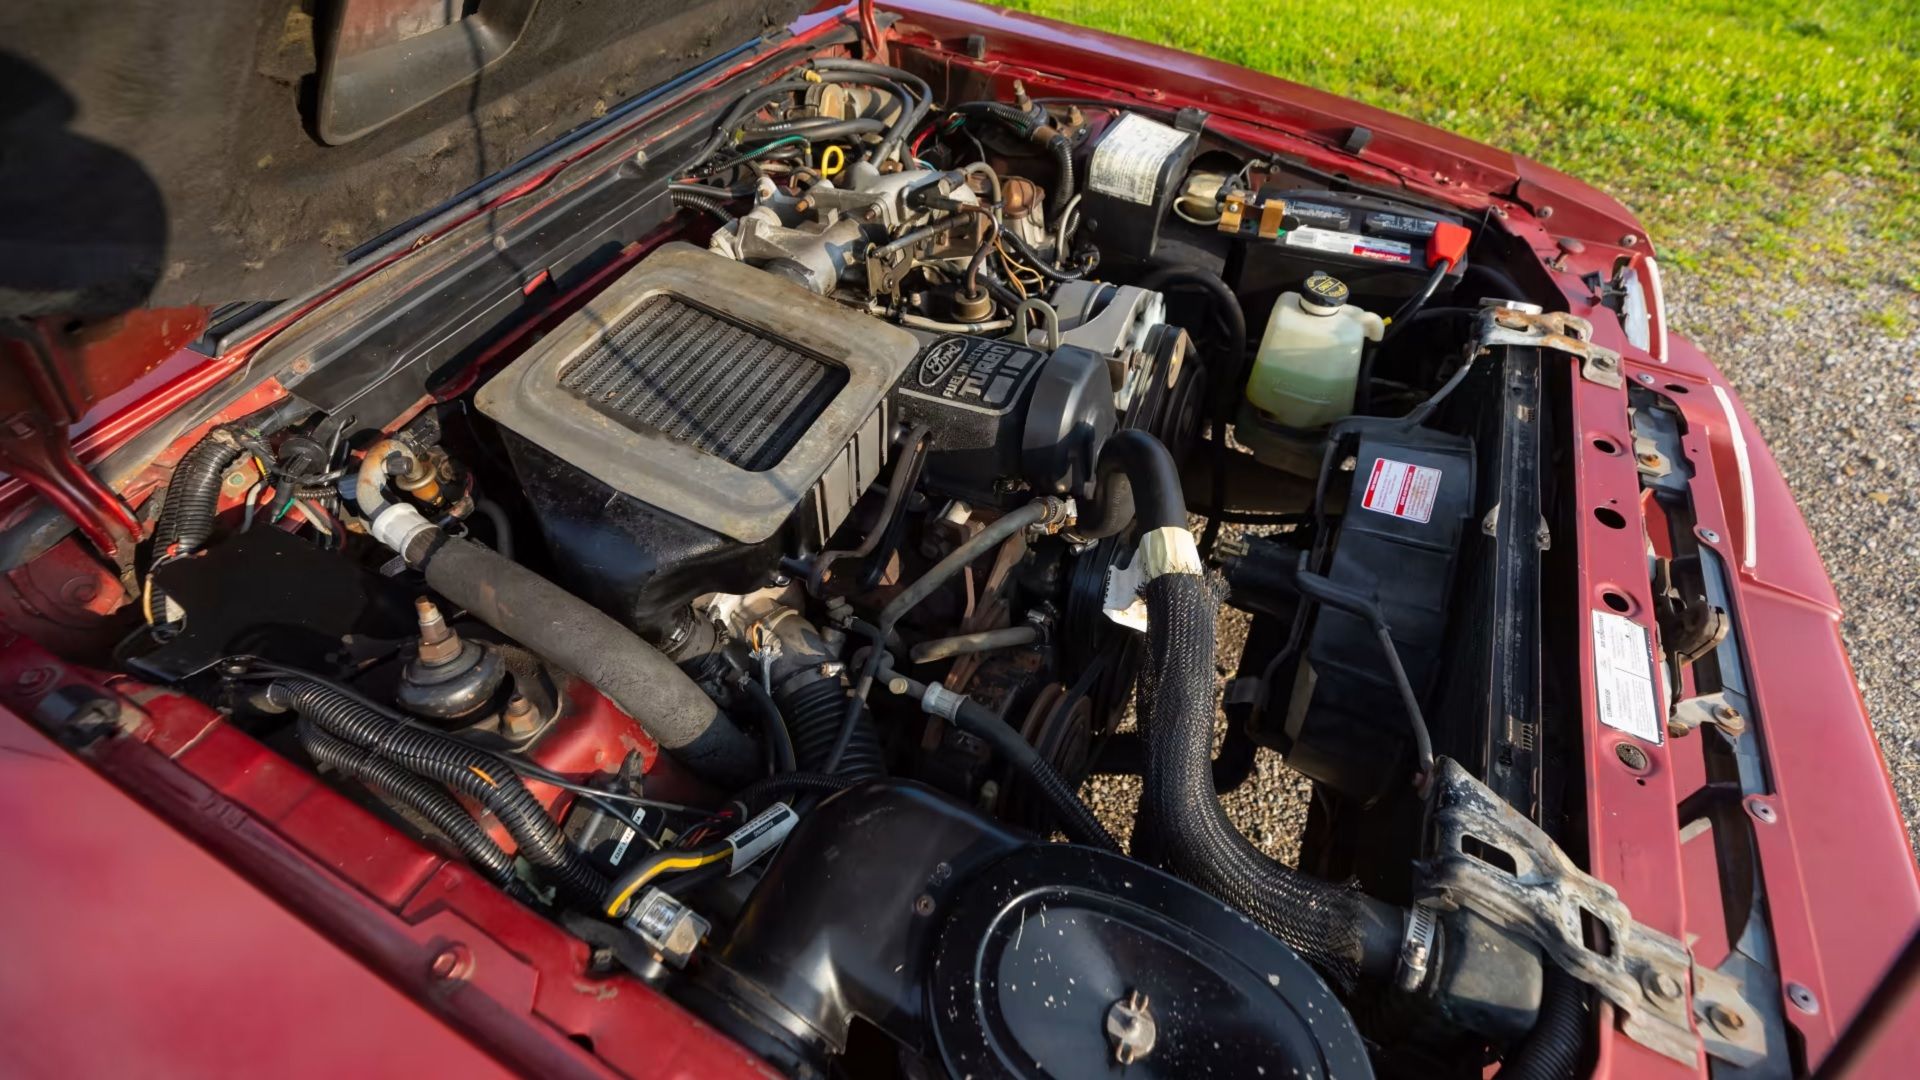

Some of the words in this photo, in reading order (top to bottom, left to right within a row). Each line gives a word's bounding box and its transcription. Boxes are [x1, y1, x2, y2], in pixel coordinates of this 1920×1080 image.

[926, 343, 961, 375] Ford
[942, 374, 967, 398] FUEL
[958, 341, 993, 374] INJECTION
[957, 345, 1011, 397] TURBO
